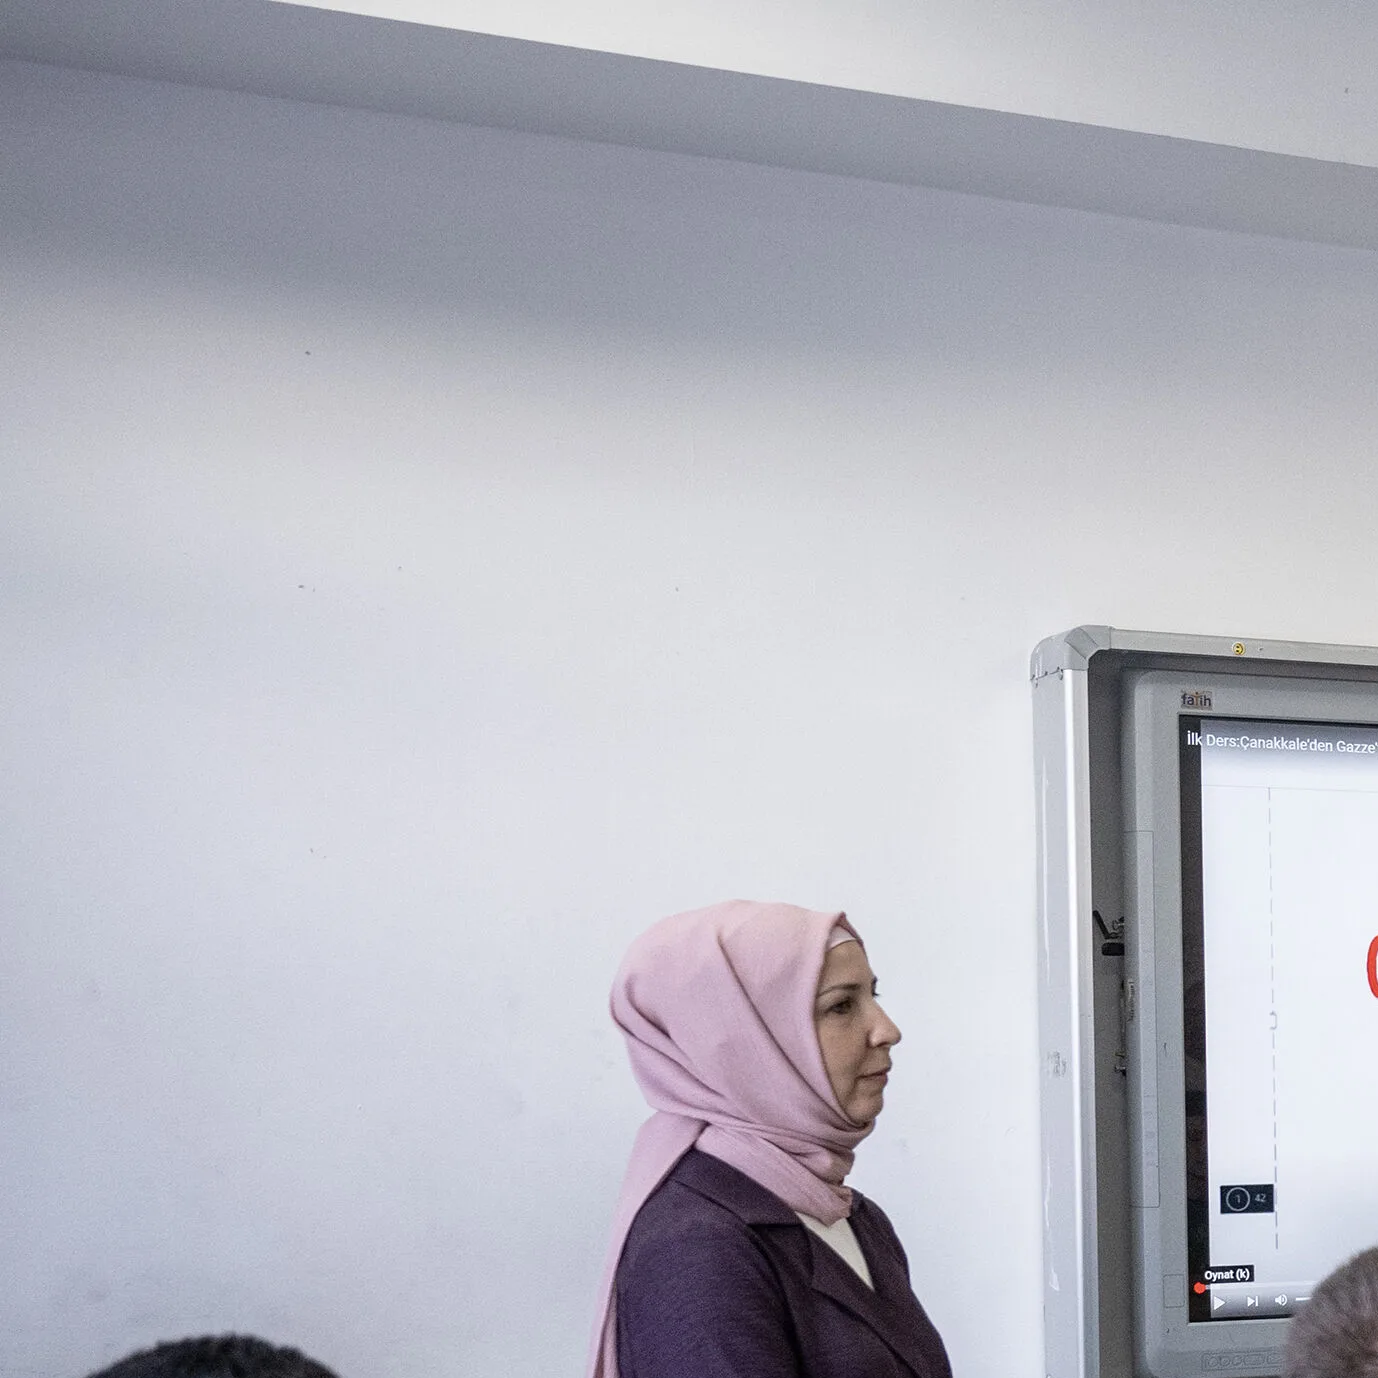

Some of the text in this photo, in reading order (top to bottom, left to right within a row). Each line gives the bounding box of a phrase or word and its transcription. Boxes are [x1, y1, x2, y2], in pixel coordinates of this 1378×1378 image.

[1181, 691, 1212, 706] fatih
[1186, 730, 1203, 746] İlk
[1206, 733, 1333, 752] Ders:Çanakkale'den
[1204, 1268, 1250, 1282] Oynat (k)
